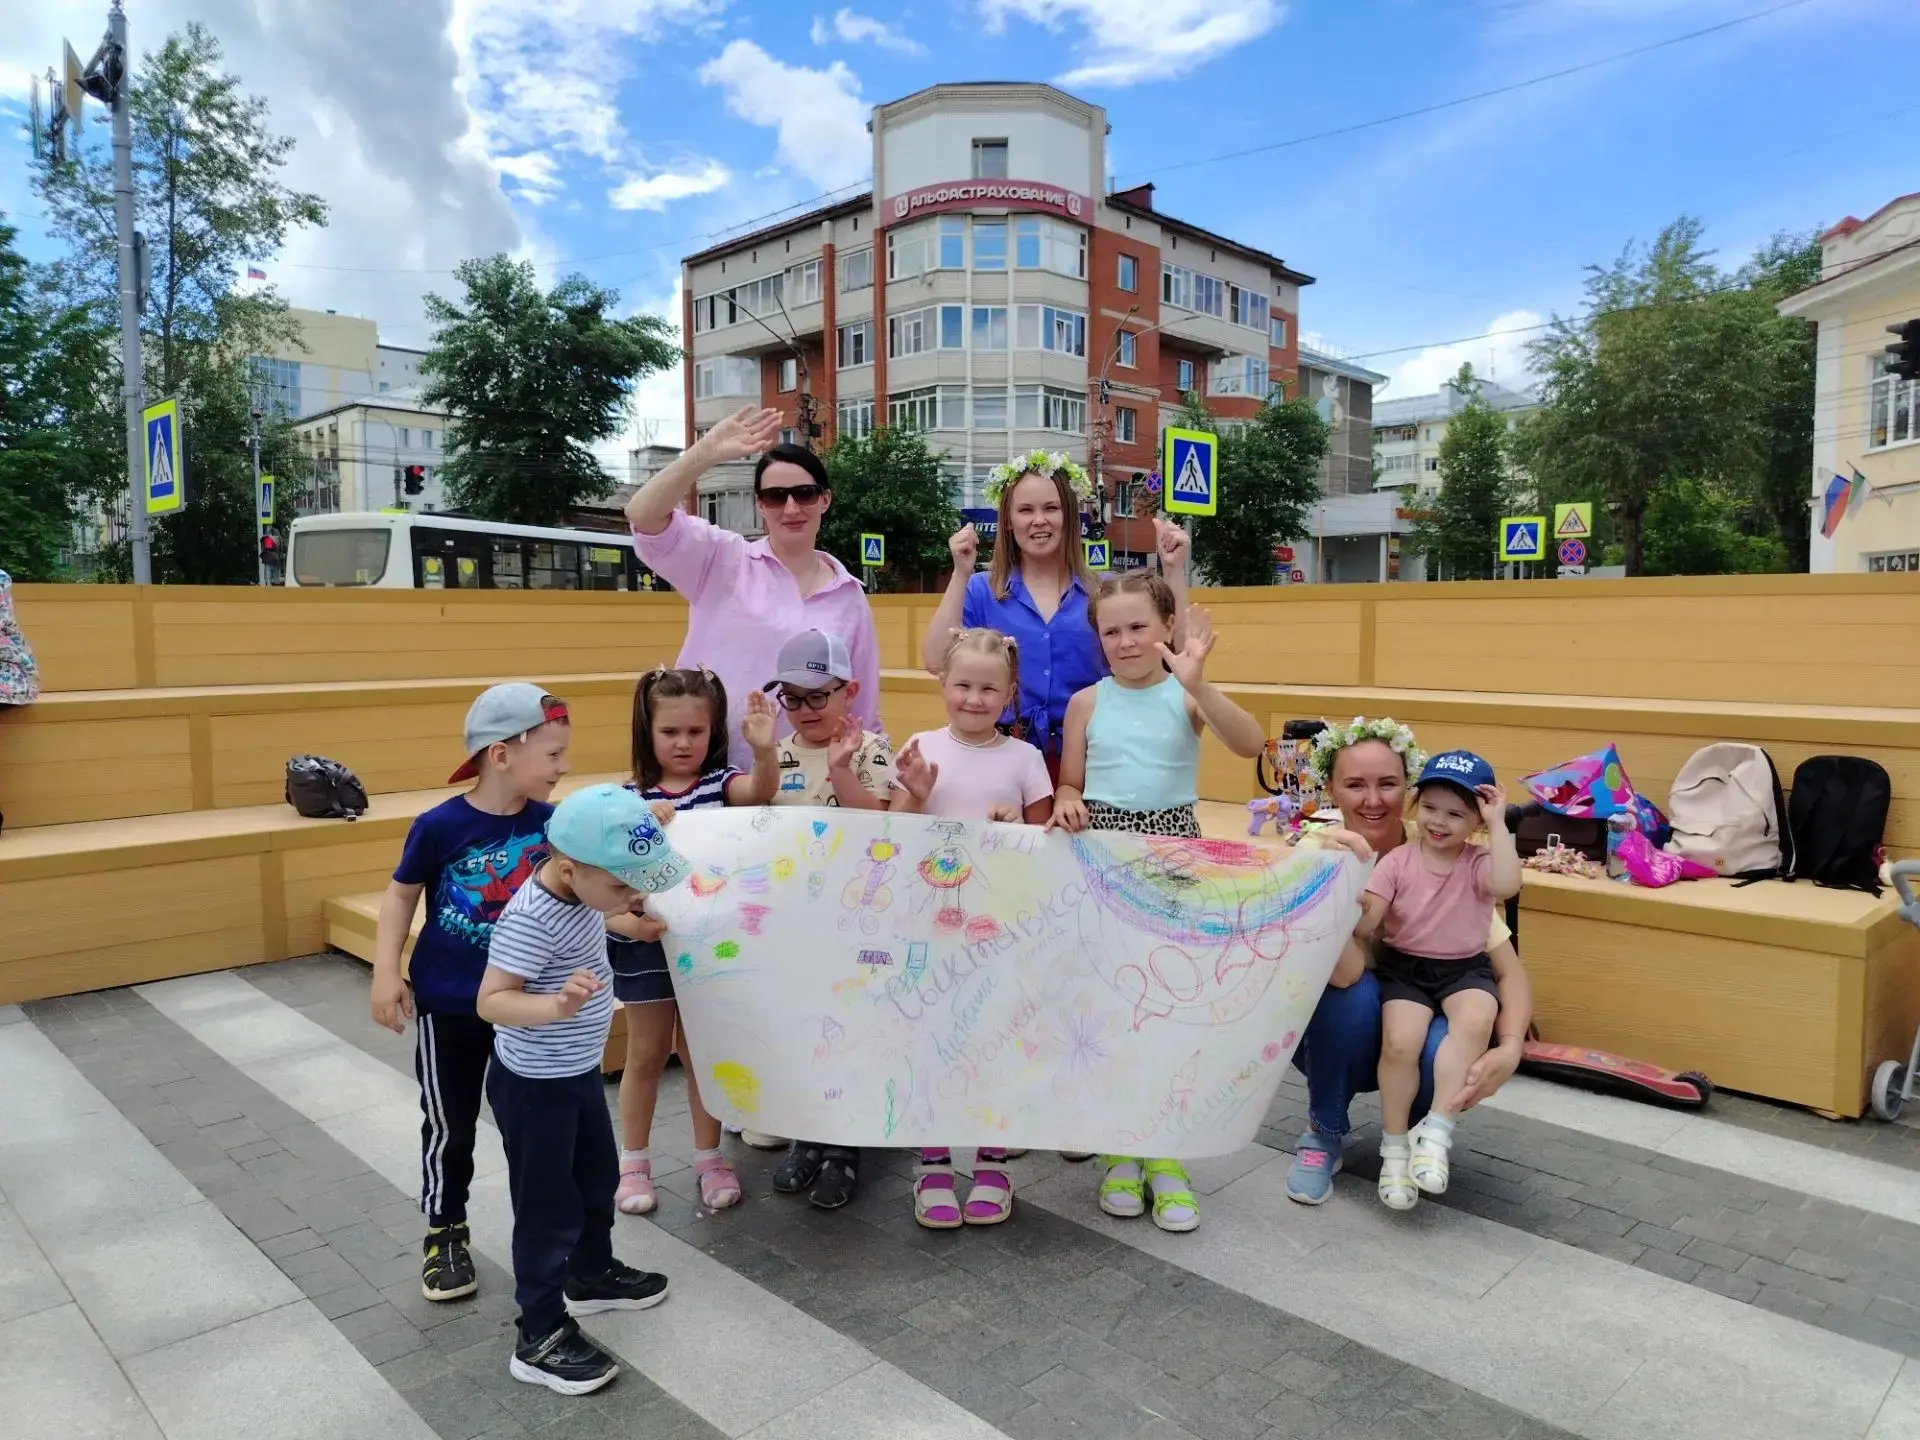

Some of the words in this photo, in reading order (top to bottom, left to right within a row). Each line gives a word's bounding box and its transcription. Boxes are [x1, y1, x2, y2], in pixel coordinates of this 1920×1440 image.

[911, 186, 1065, 209] АЛЬФАСТРАХОВАНИЕ
[1112, 556, 1139, 567] АПТЕКА
[457, 850, 508, 873] ET'S
